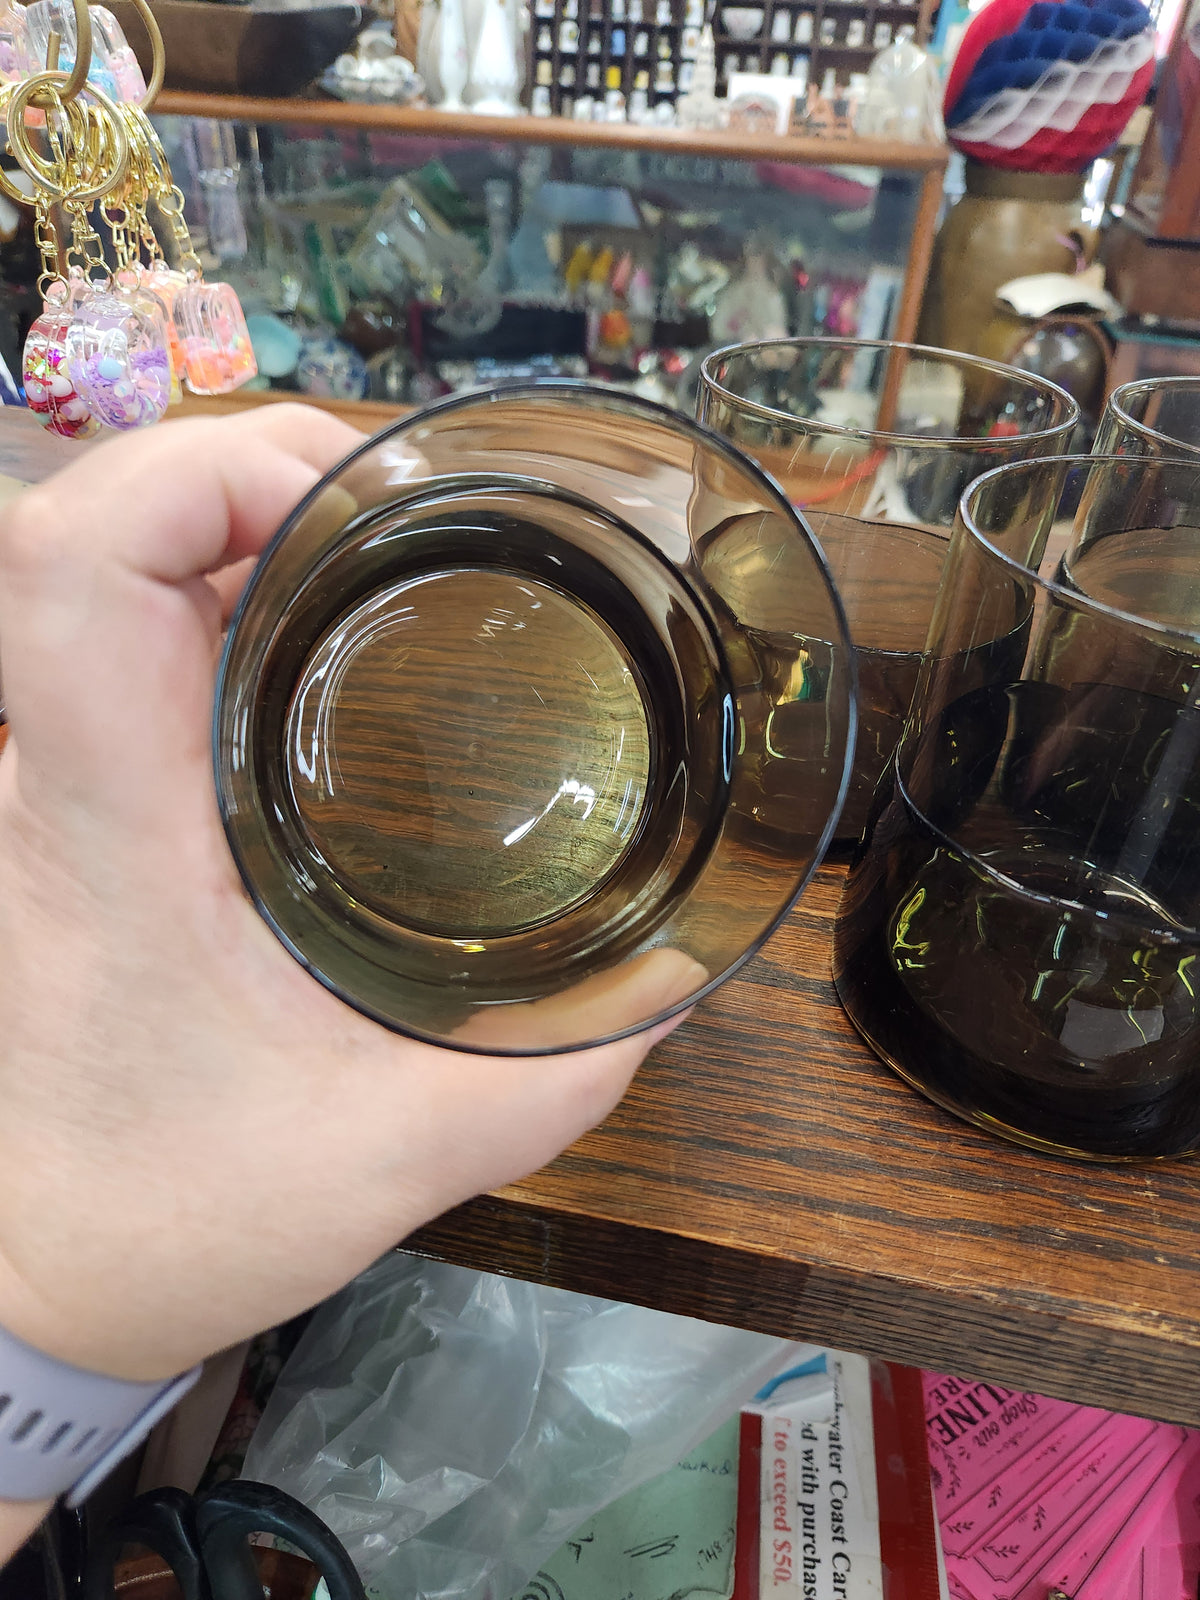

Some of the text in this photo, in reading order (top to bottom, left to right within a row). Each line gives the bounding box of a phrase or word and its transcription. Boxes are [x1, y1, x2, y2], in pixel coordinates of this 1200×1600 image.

[774, 1431, 789, 1450] to
[973, 1392, 1038, 1447] Shop our
[774, 1458, 792, 1533] exceed
[802, 1448, 819, 1495] with
[829, 1479, 848, 1544] Coast
[773, 1539, 792, 1587] $50.
[831, 1552, 852, 1600] Car
